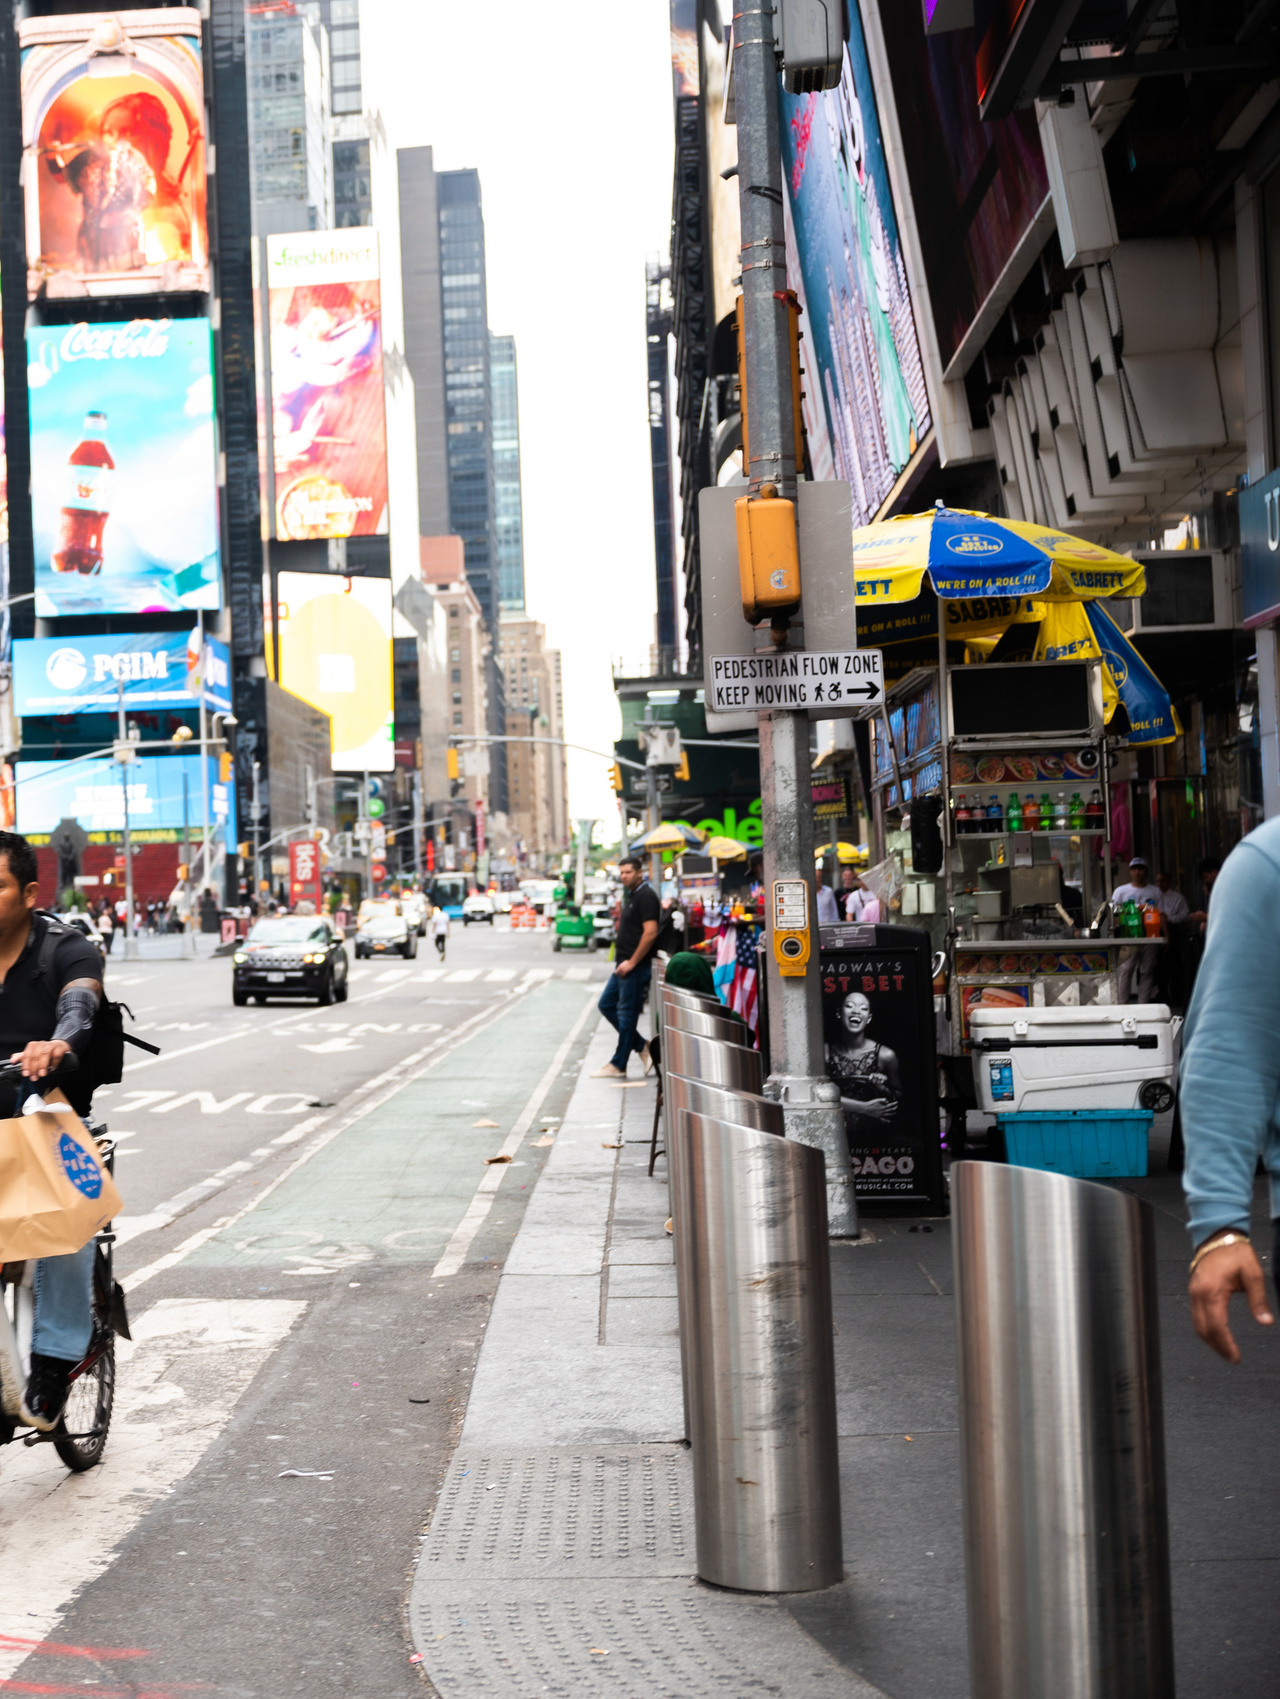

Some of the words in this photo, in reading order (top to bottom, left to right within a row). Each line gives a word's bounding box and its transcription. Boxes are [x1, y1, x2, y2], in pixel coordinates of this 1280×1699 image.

[60, 318, 173, 361] Coca-Cola
[937, 579, 966, 590] WE'RE
[969, 578, 983, 588] ON
[985, 578, 992, 587] A
[995, 575, 1020, 586] ROLL
[1070, 570, 1124, 588] SABRETT
[871, 623, 884, 633] ON
[886, 621, 893, 630] A
[895, 616, 918, 628] ROLL
[92, 650, 169, 682] PGIM
[714, 658, 799, 680] PEDESTRIAN
[803, 656, 839, 676] FLOW
[844, 655, 879, 674] ZONE
[716, 686, 749, 706] KEEP
[755, 683, 806, 704] MOVING
[296, 843, 315, 881] tkts
[823, 976, 850, 993] ST
[861, 975, 905, 992] BET
[991, 1069, 1001, 1080] 5
